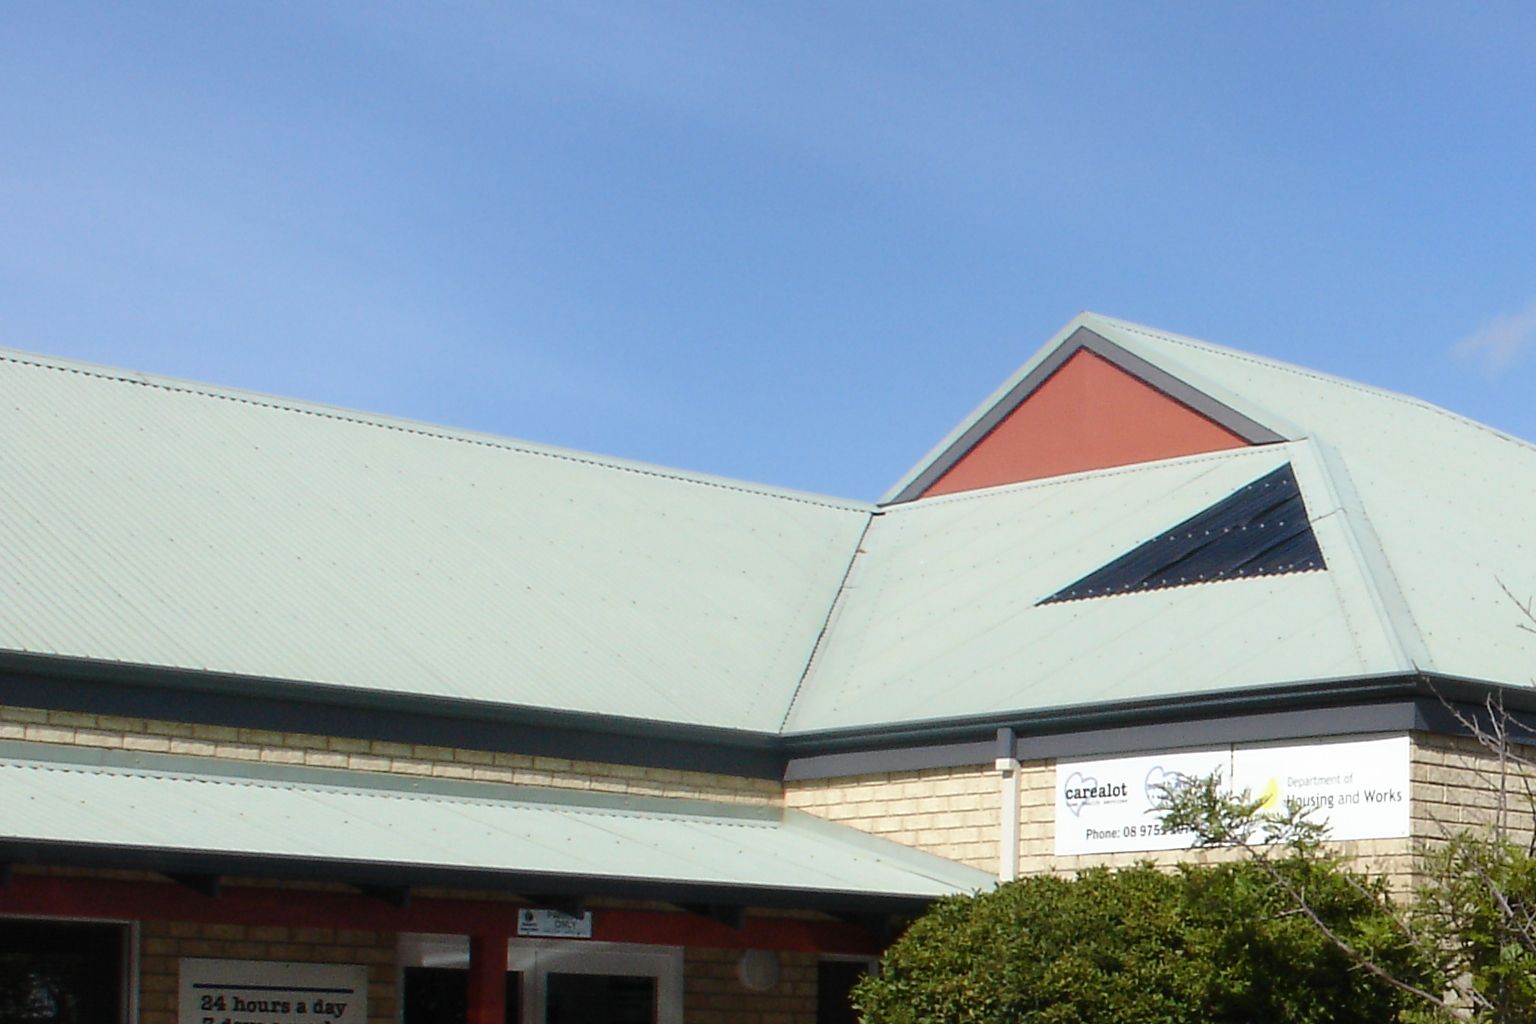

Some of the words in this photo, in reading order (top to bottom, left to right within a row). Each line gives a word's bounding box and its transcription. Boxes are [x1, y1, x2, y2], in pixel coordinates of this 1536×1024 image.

[1287, 775, 1340, 788] Department
[1343, 773, 1353, 784] of
[1065, 782, 1128, 800] carealot
[1338, 792, 1360, 805] and
[1364, 789, 1402, 803] Works
[1086, 828, 1120, 840] Phone:
[1123, 826, 1137, 838] 08
[200, 995, 226, 1012] 24
[232, 997, 291, 1014] hours
[296, 1001, 307, 1013] a
[313, 999, 347, 1018] day
